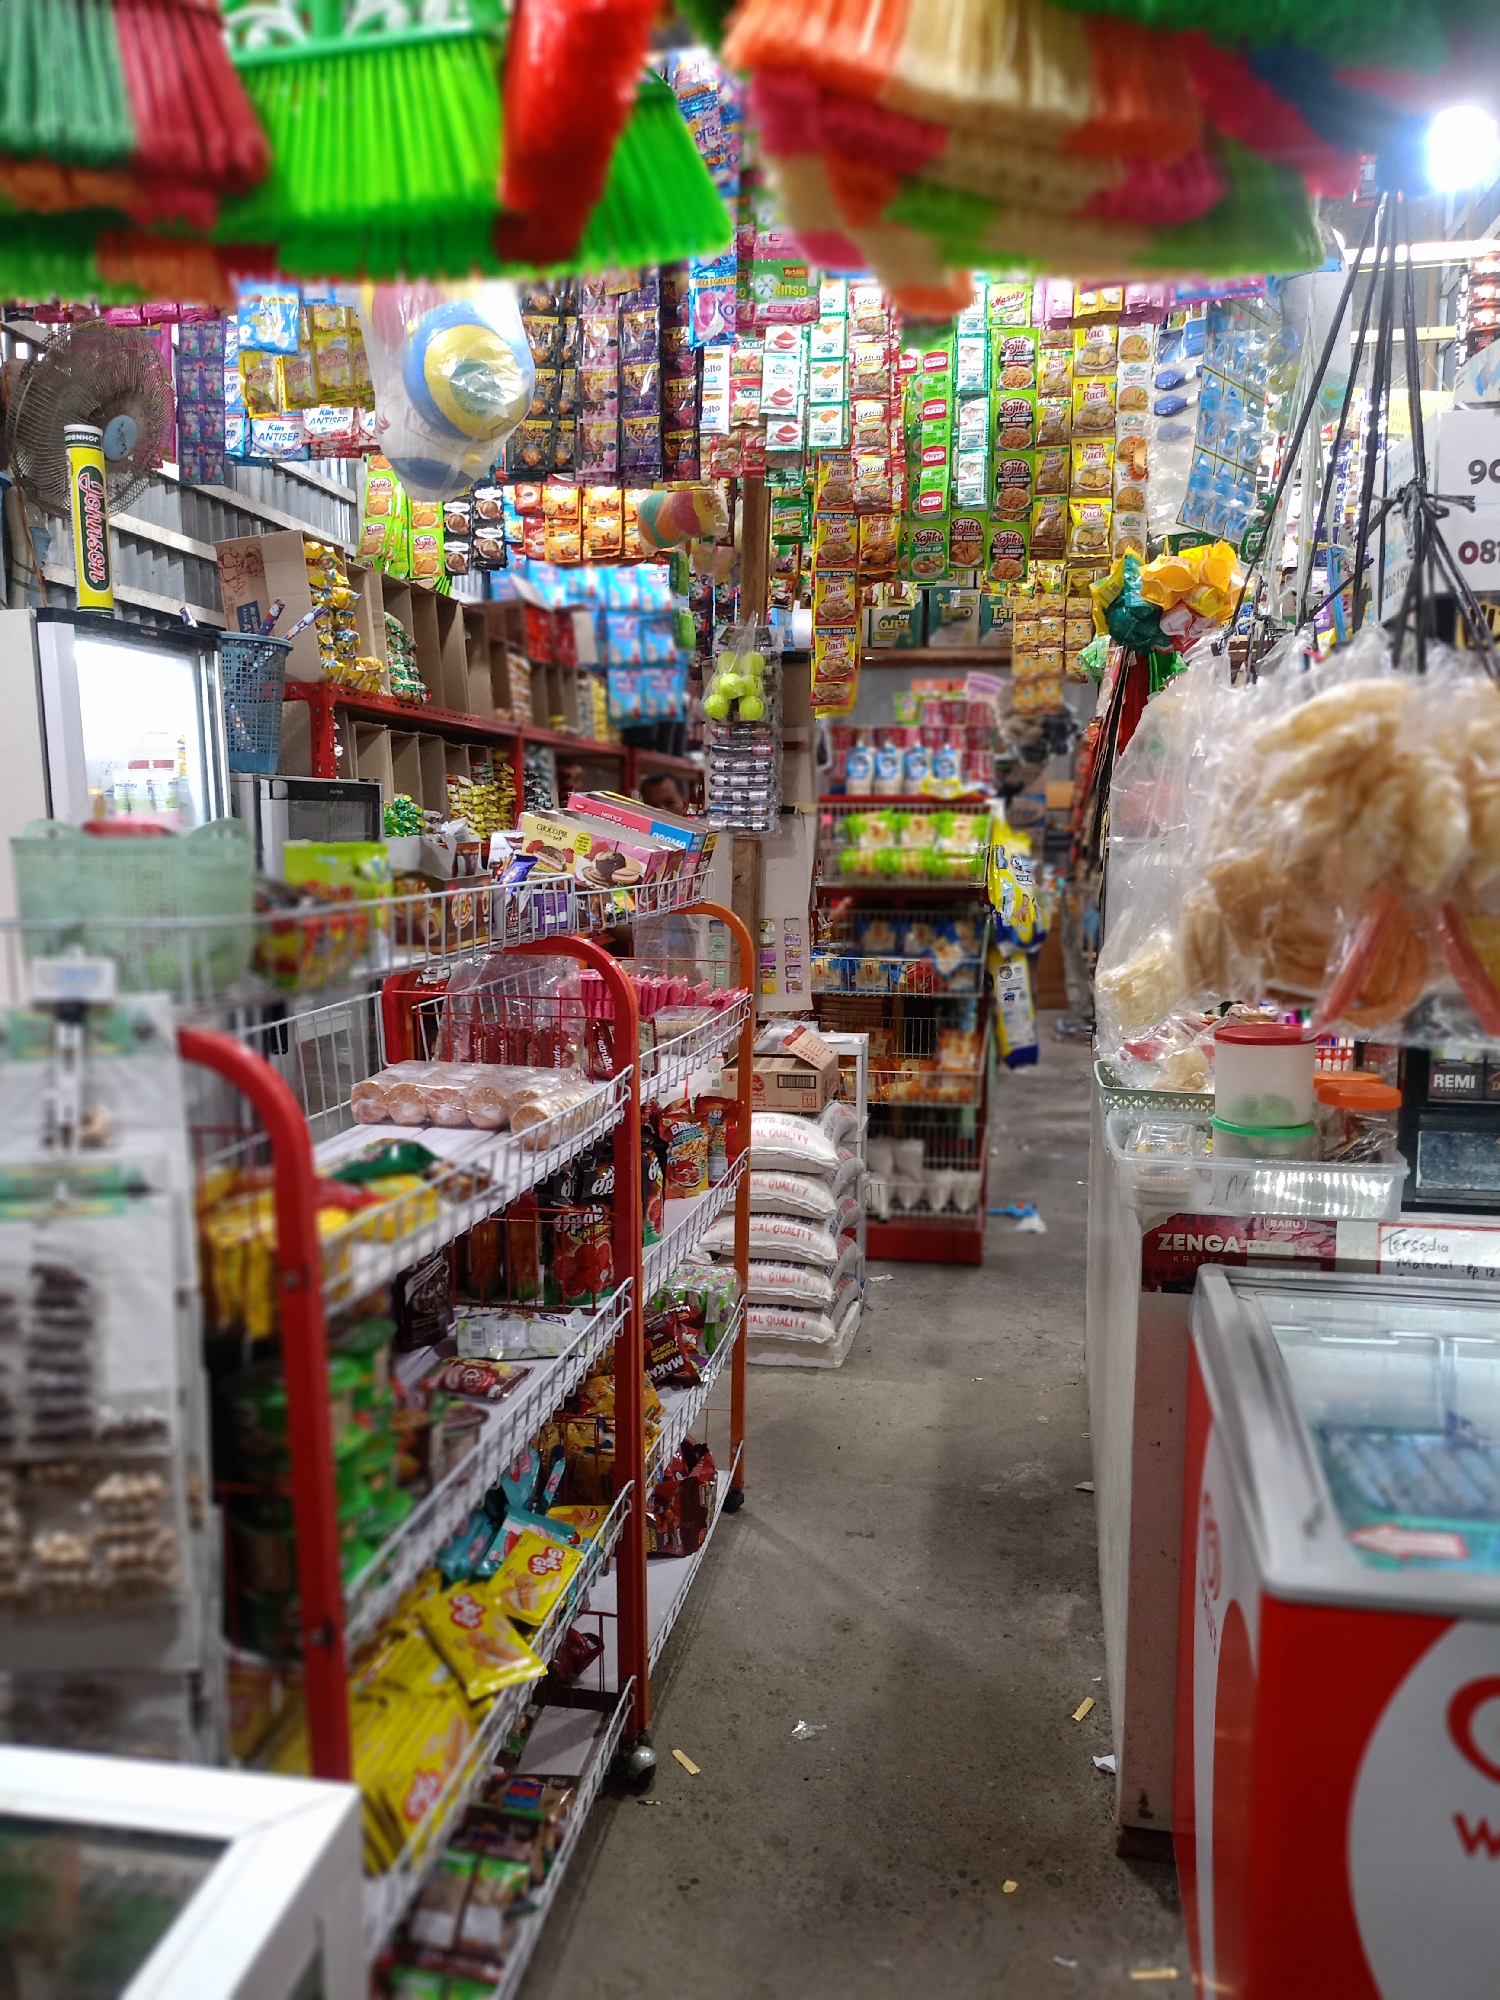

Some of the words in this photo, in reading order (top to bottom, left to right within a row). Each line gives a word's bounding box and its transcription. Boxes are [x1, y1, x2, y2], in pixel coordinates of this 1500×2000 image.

[773, 281, 807, 296] Rinso
[1085, 328, 1104, 340] Raci
[1000, 340, 1027, 355] Sajik
[1084, 390, 1109, 401] Racik
[1000, 401, 1032, 415] Sajiku
[268, 424, 284, 432] Klin
[1082, 450, 1107, 461] Racik
[998, 462, 1030, 476] Sajiku
[1080, 508, 1105, 520] Racik
[78, 473, 106, 584] Johnson
[826, 524, 849, 536] Racik
[867, 521, 891, 532] Racik
[951, 522, 982, 535] Sajiku
[912, 532, 944, 546] Sajiku
[993, 533, 1024, 548] Sajiku
[824, 583, 847, 594] Racik
[991, 605, 1016, 619] Tar
[824, 640, 847, 651] Racik
[1433, 1074, 1476, 1090] REMI
[769, 1128, 809, 1145] QUALITY
[768, 1178, 809, 1197] QUALITY
[1270, 1218, 1300, 1228] BARU
[773, 1224, 814, 1242] QUALITY
[1158, 1233, 1241, 1254] ZENGA
[766, 1315, 807, 1329] QUALITY
[645, 1355, 684, 1380] MAKA
